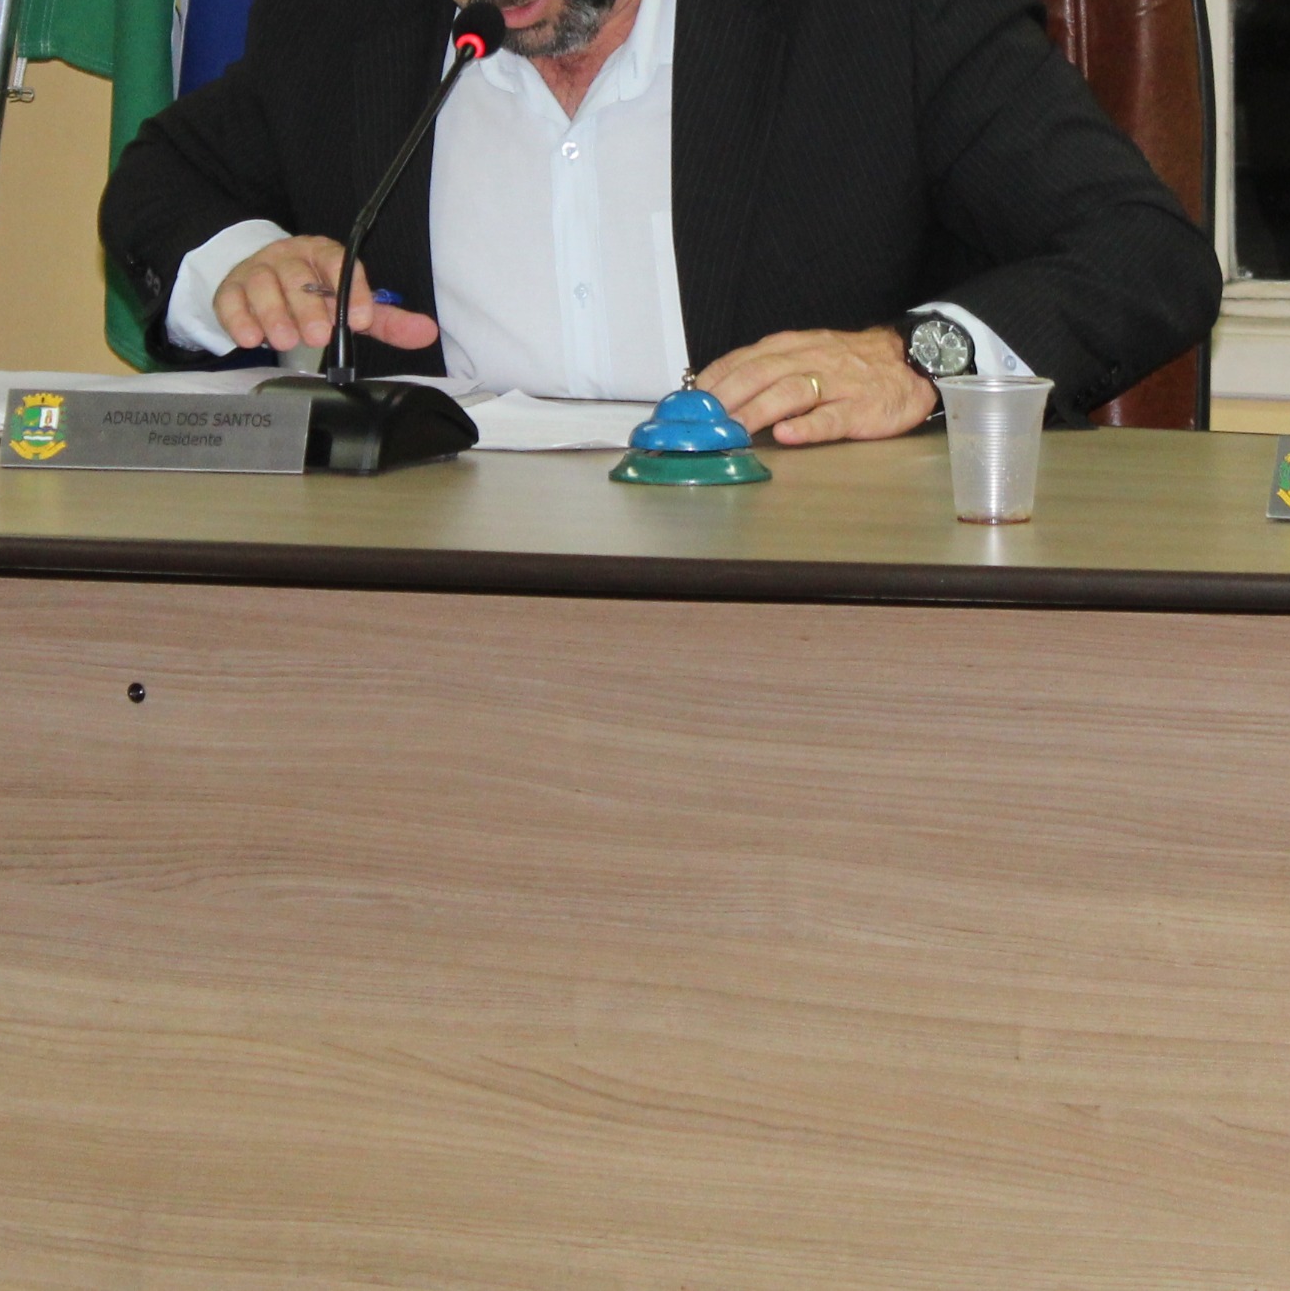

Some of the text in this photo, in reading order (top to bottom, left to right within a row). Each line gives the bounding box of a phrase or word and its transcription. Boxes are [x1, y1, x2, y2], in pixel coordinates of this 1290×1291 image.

[102, 411, 271, 428] ADRIANO DOS SANTOS
[147, 431, 223, 447] Presidente
